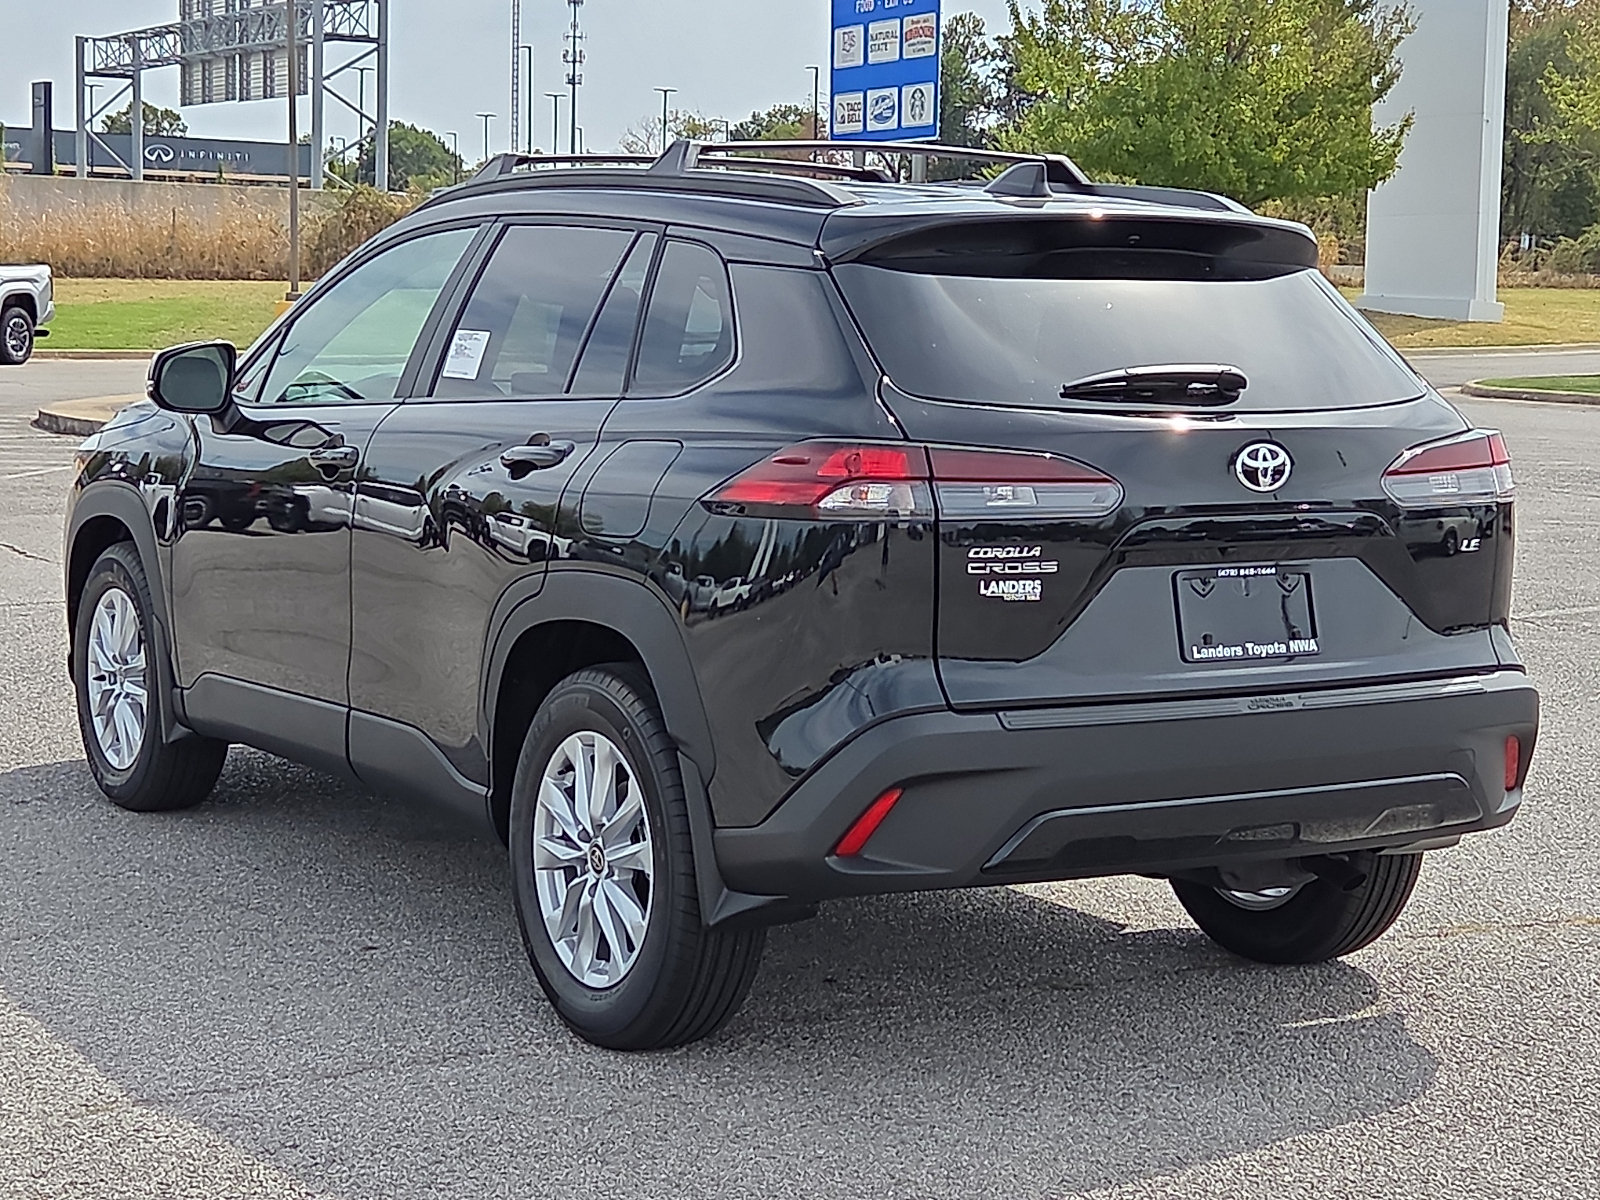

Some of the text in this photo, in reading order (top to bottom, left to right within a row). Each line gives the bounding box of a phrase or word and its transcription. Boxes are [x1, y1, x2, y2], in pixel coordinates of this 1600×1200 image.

[847, 101, 861, 112] TACO
[180, 149, 250, 162] INFINITI
[1460, 539, 1480, 551] LE
[968, 546, 1041, 558] COROLLA
[967, 561, 1058, 574] CROSS
[980, 580, 1041, 596] LANDERS
[1192, 639, 1318, 659] Landers Toyota NWA
